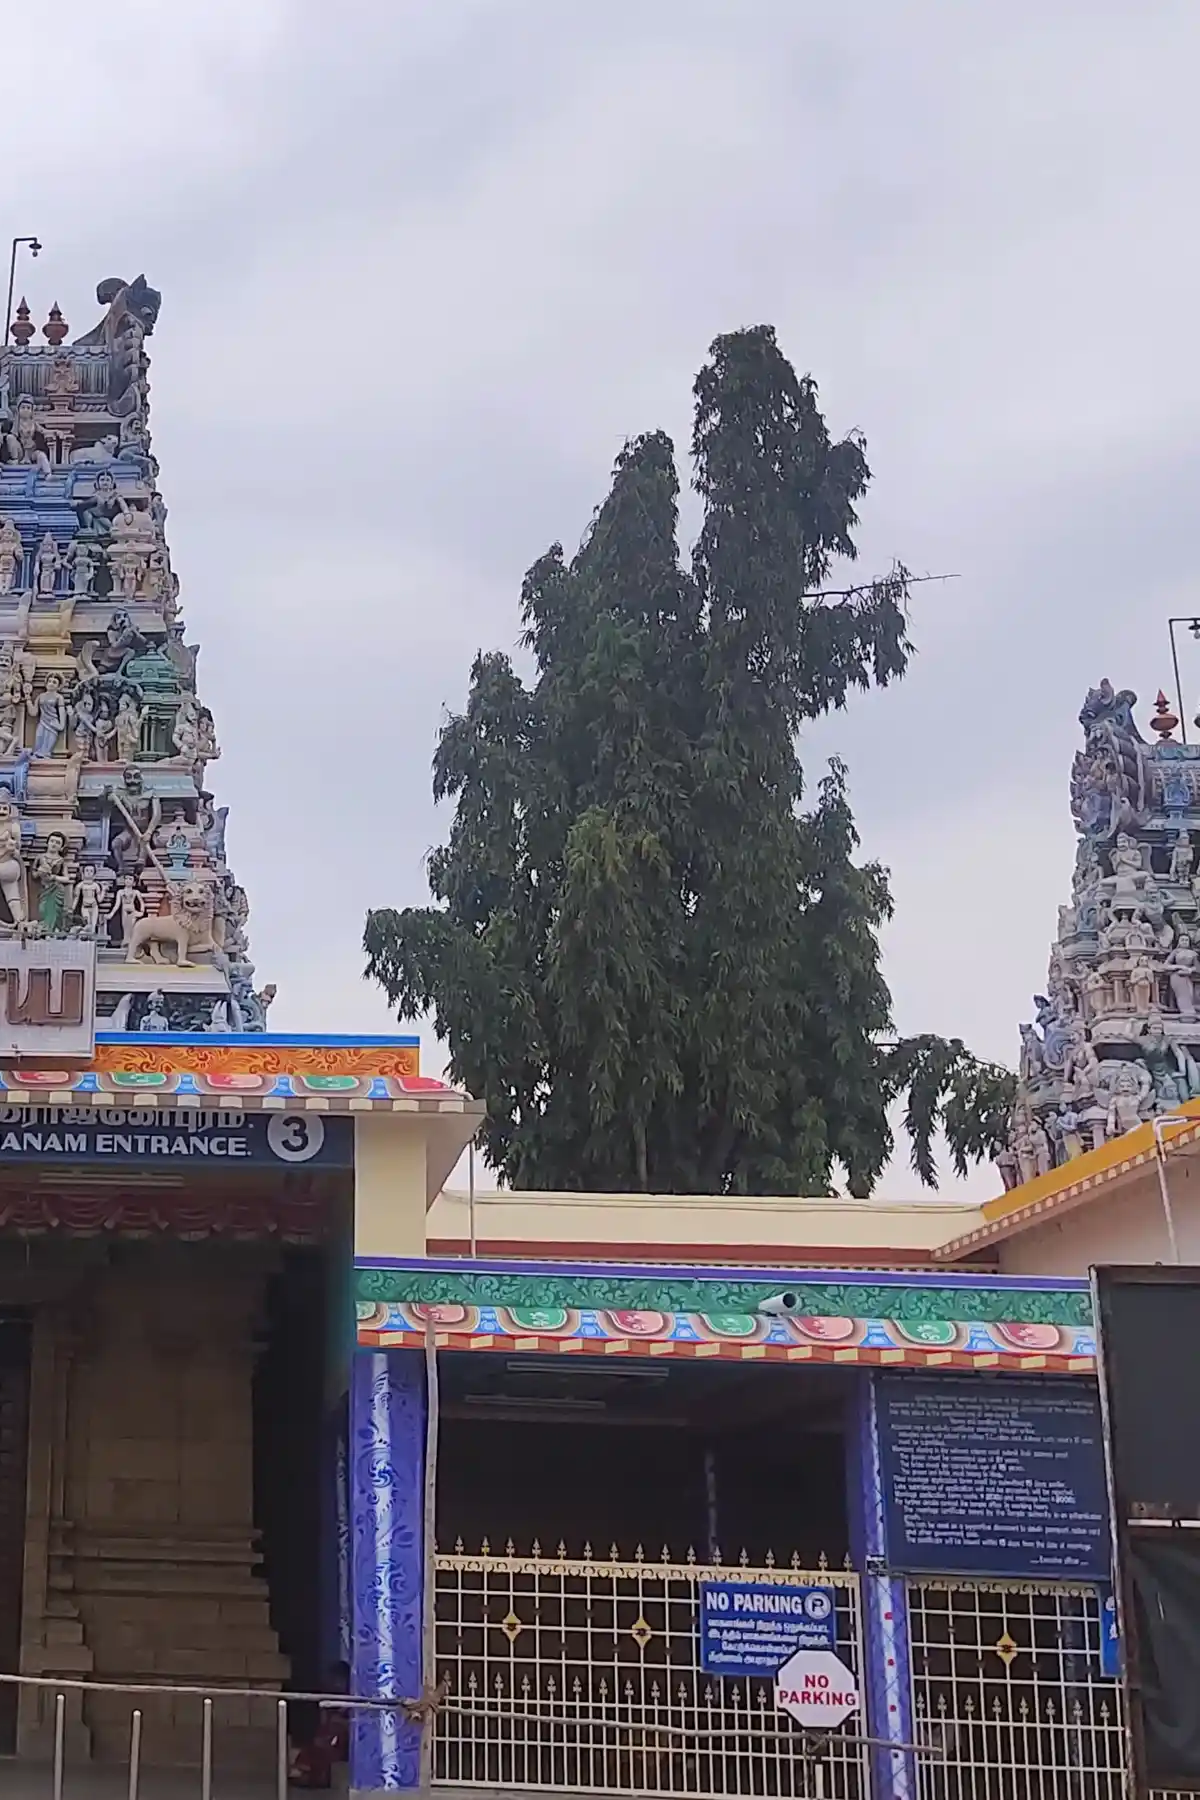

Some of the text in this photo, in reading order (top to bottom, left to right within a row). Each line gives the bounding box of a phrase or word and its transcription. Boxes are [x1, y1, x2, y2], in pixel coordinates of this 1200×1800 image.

[95, 1134, 253, 1157] ENTRANCE.
[281, 1115, 310, 1153] 3
[706, 1591, 729, 1611] NO
[734, 1594, 804, 1615] PARKING
[804, 1674, 830, 1689] NO
[779, 1690, 857, 1706] PARKING
